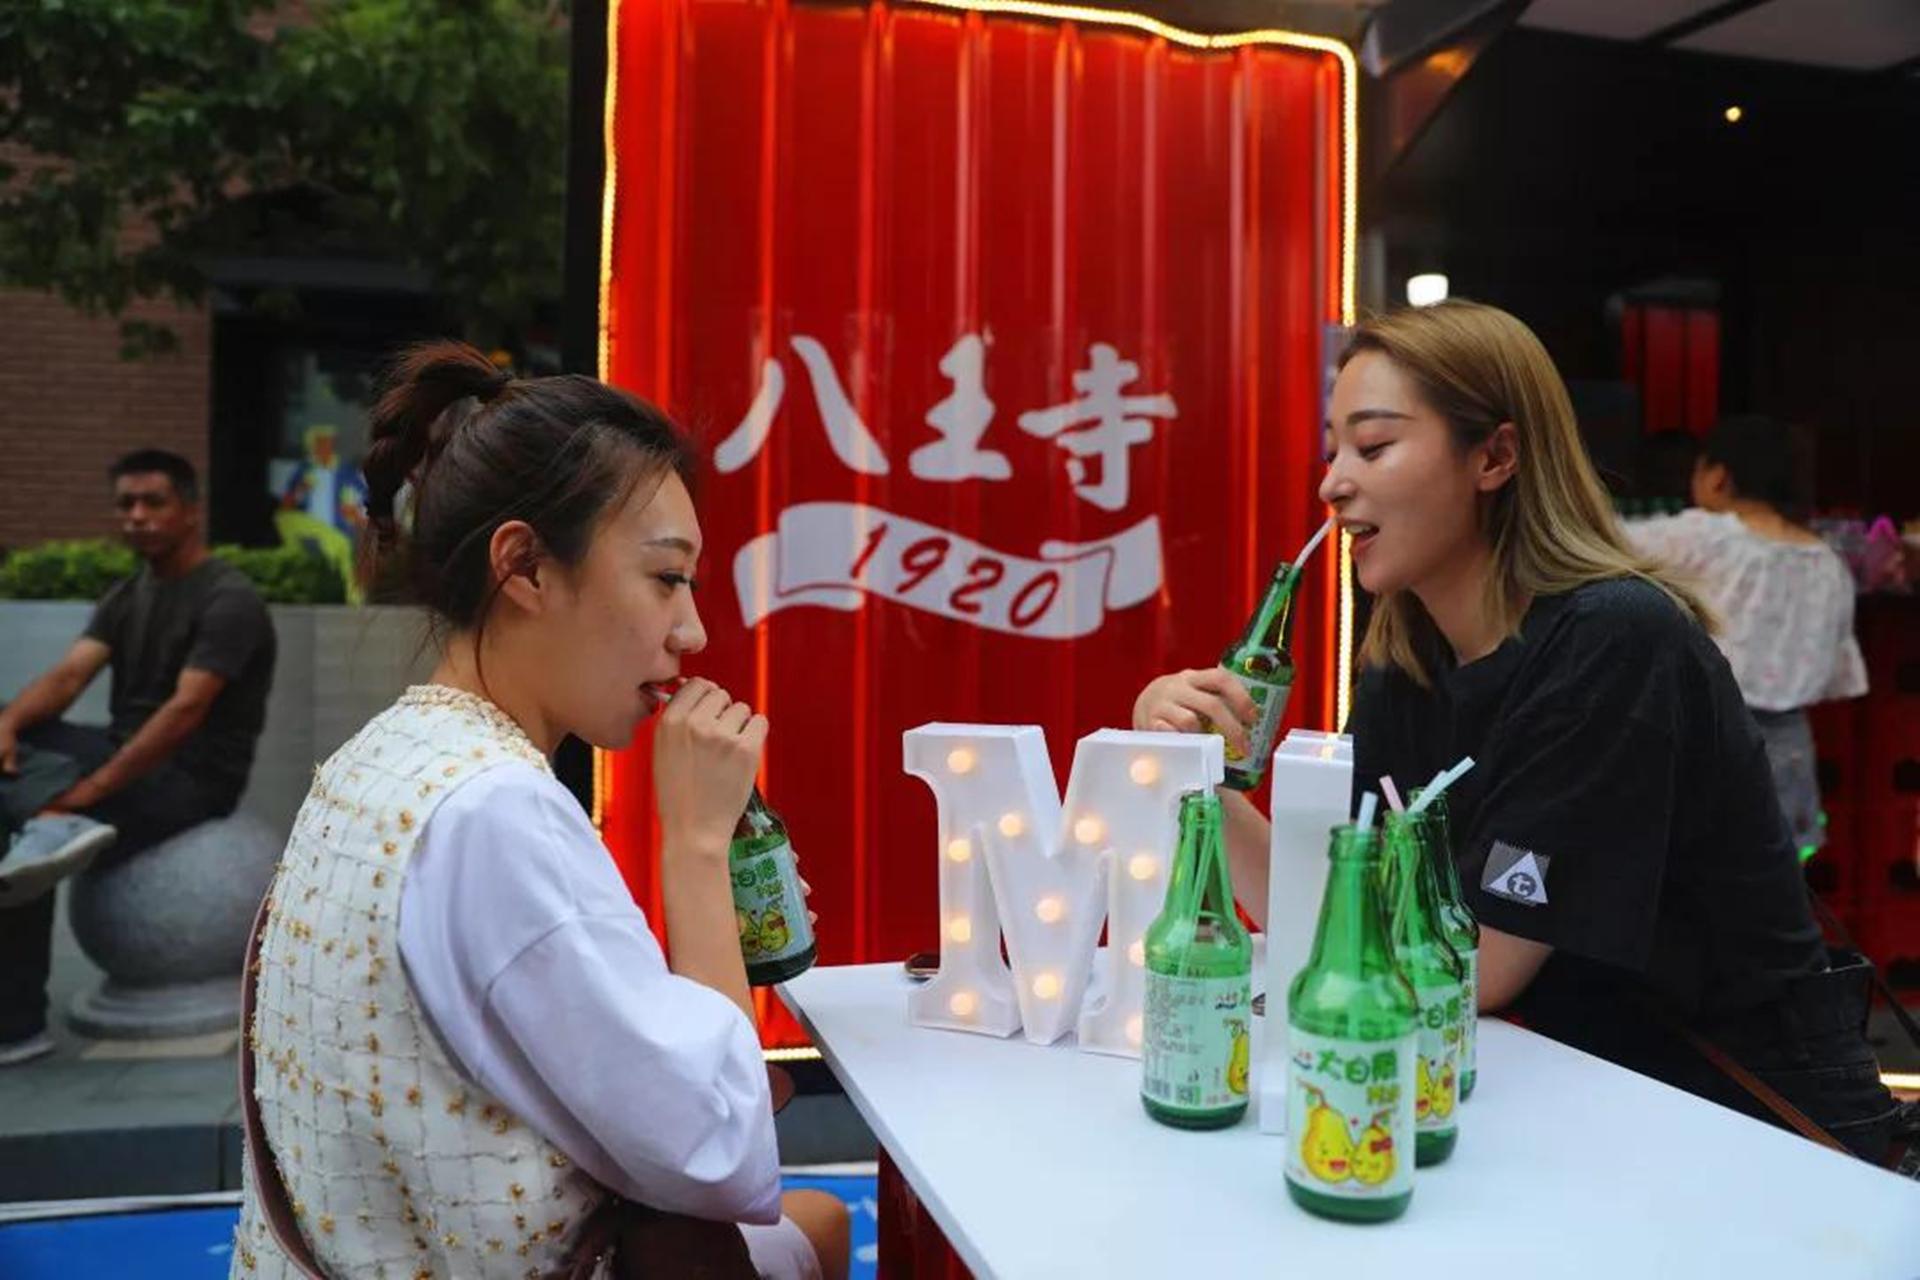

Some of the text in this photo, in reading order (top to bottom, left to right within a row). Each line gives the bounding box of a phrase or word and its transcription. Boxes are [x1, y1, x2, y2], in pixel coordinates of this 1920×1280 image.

[713, 333, 1179, 511] 八王寺
[850, 521, 1060, 629] 1920
[903, 722, 1224, 1058] M
